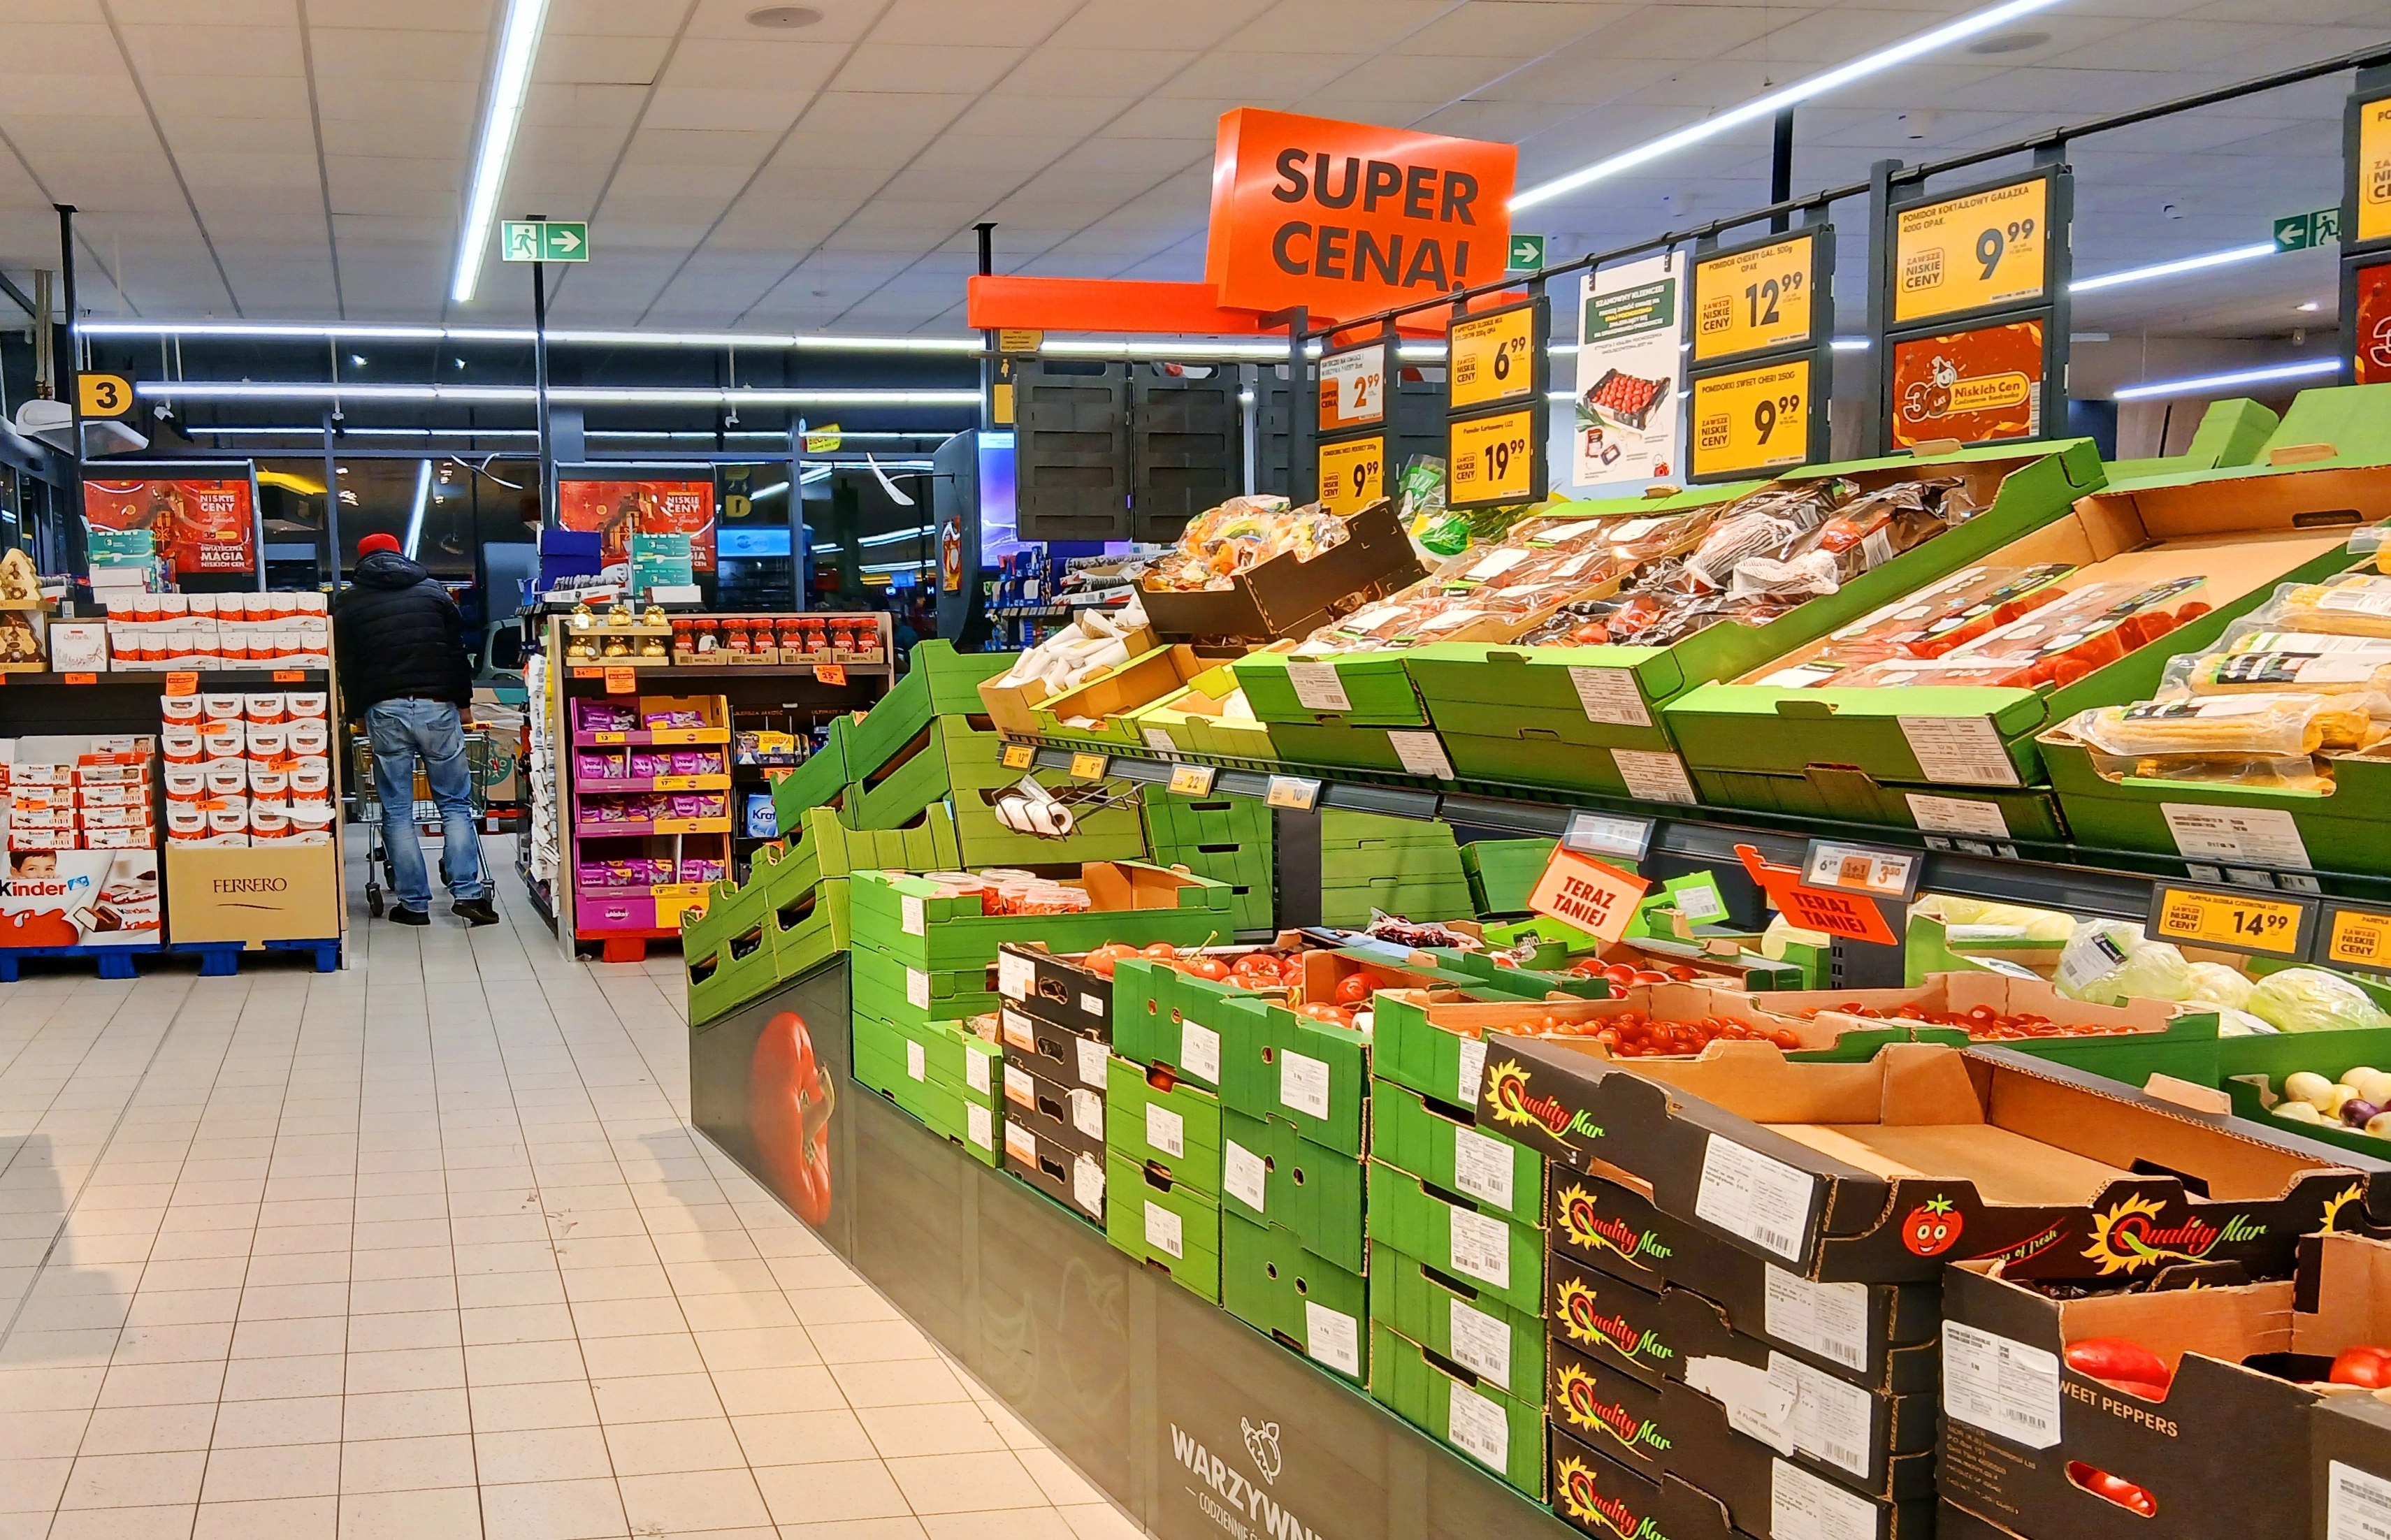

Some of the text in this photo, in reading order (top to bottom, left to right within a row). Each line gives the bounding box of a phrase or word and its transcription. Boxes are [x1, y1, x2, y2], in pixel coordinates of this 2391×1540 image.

[1272, 147, 1478, 226] SUPER
[1903, 208, 1937, 223] POMIDOR
[1938, 196, 1989, 215] KOKTAJLOWY
[1903, 222, 1922, 233] 400G
[1272, 221, 1469, 292] CENA!
[1907, 252, 1940, 266] ZAWSZE
[1709, 259, 1735, 271] POMIDOR
[1906, 261, 1940, 276] NISKIE
[1906, 273, 1940, 289] CENY
[1703, 307, 1730, 320] NISKIE
[1703, 317, 1730, 331] CENY
[1457, 372, 1475, 383] CENY
[1702, 382, 1735, 393] POMIDORKI
[1736, 377, 1756, 388] SWEET
[96, 382, 117, 408] 3
[1322, 391, 1337, 399] SUPER
[1955, 382, 2020, 398] Niskich Cen
[1933, 395, 1946, 407] LAT
[1702, 417, 1728, 426] ZAWSZE
[1702, 425, 1728, 436] NISKIE
[1702, 435, 1728, 446] CENY
[1457, 471, 1475, 480] CENY
[201, 502, 235, 512] CENY
[667, 496, 700, 504] NISKIE
[667, 504, 700, 513] CENY
[201, 544, 243, 552] ŚWIĄTECZNA
[201, 551, 244, 561] MAGIA
[0, 880, 66, 896] Kinder
[213, 878, 288, 894] FERRERO
[1562, 876, 1617, 909] TERAZ
[1552, 893, 1607, 927] TANIEJ
[1789, 892, 1856, 915] TERAZ
[1800, 910, 1868, 934] TANIEJ
[2170, 912, 2199, 921] NISKIE
[2169, 920, 2197, 930] CENY
[2342, 936, 2375, 945] NISKIE
[2341, 945, 2374, 955] CENY
[1503, 1079, 1605, 1139] Quality Mar
[1574, 1203, 1673, 1259] Quality Mar
[2114, 1214, 2269, 1255] Quality Mar
[2014, 1244, 2025, 1258] of
[2029, 1229, 2058, 1255] fresh
[1573, 1297, 1675, 1359] Quality Mar
[2059, 1380, 2179, 1437] WEET PEPPERS
[1572, 1383, 1673, 1451] Quality Mar
[1170, 1422, 1323, 1540] WARZYWN
[1572, 1476, 1638, 1536] Quality
[1199, 1491, 1249, 1540] CODZIENNIE
